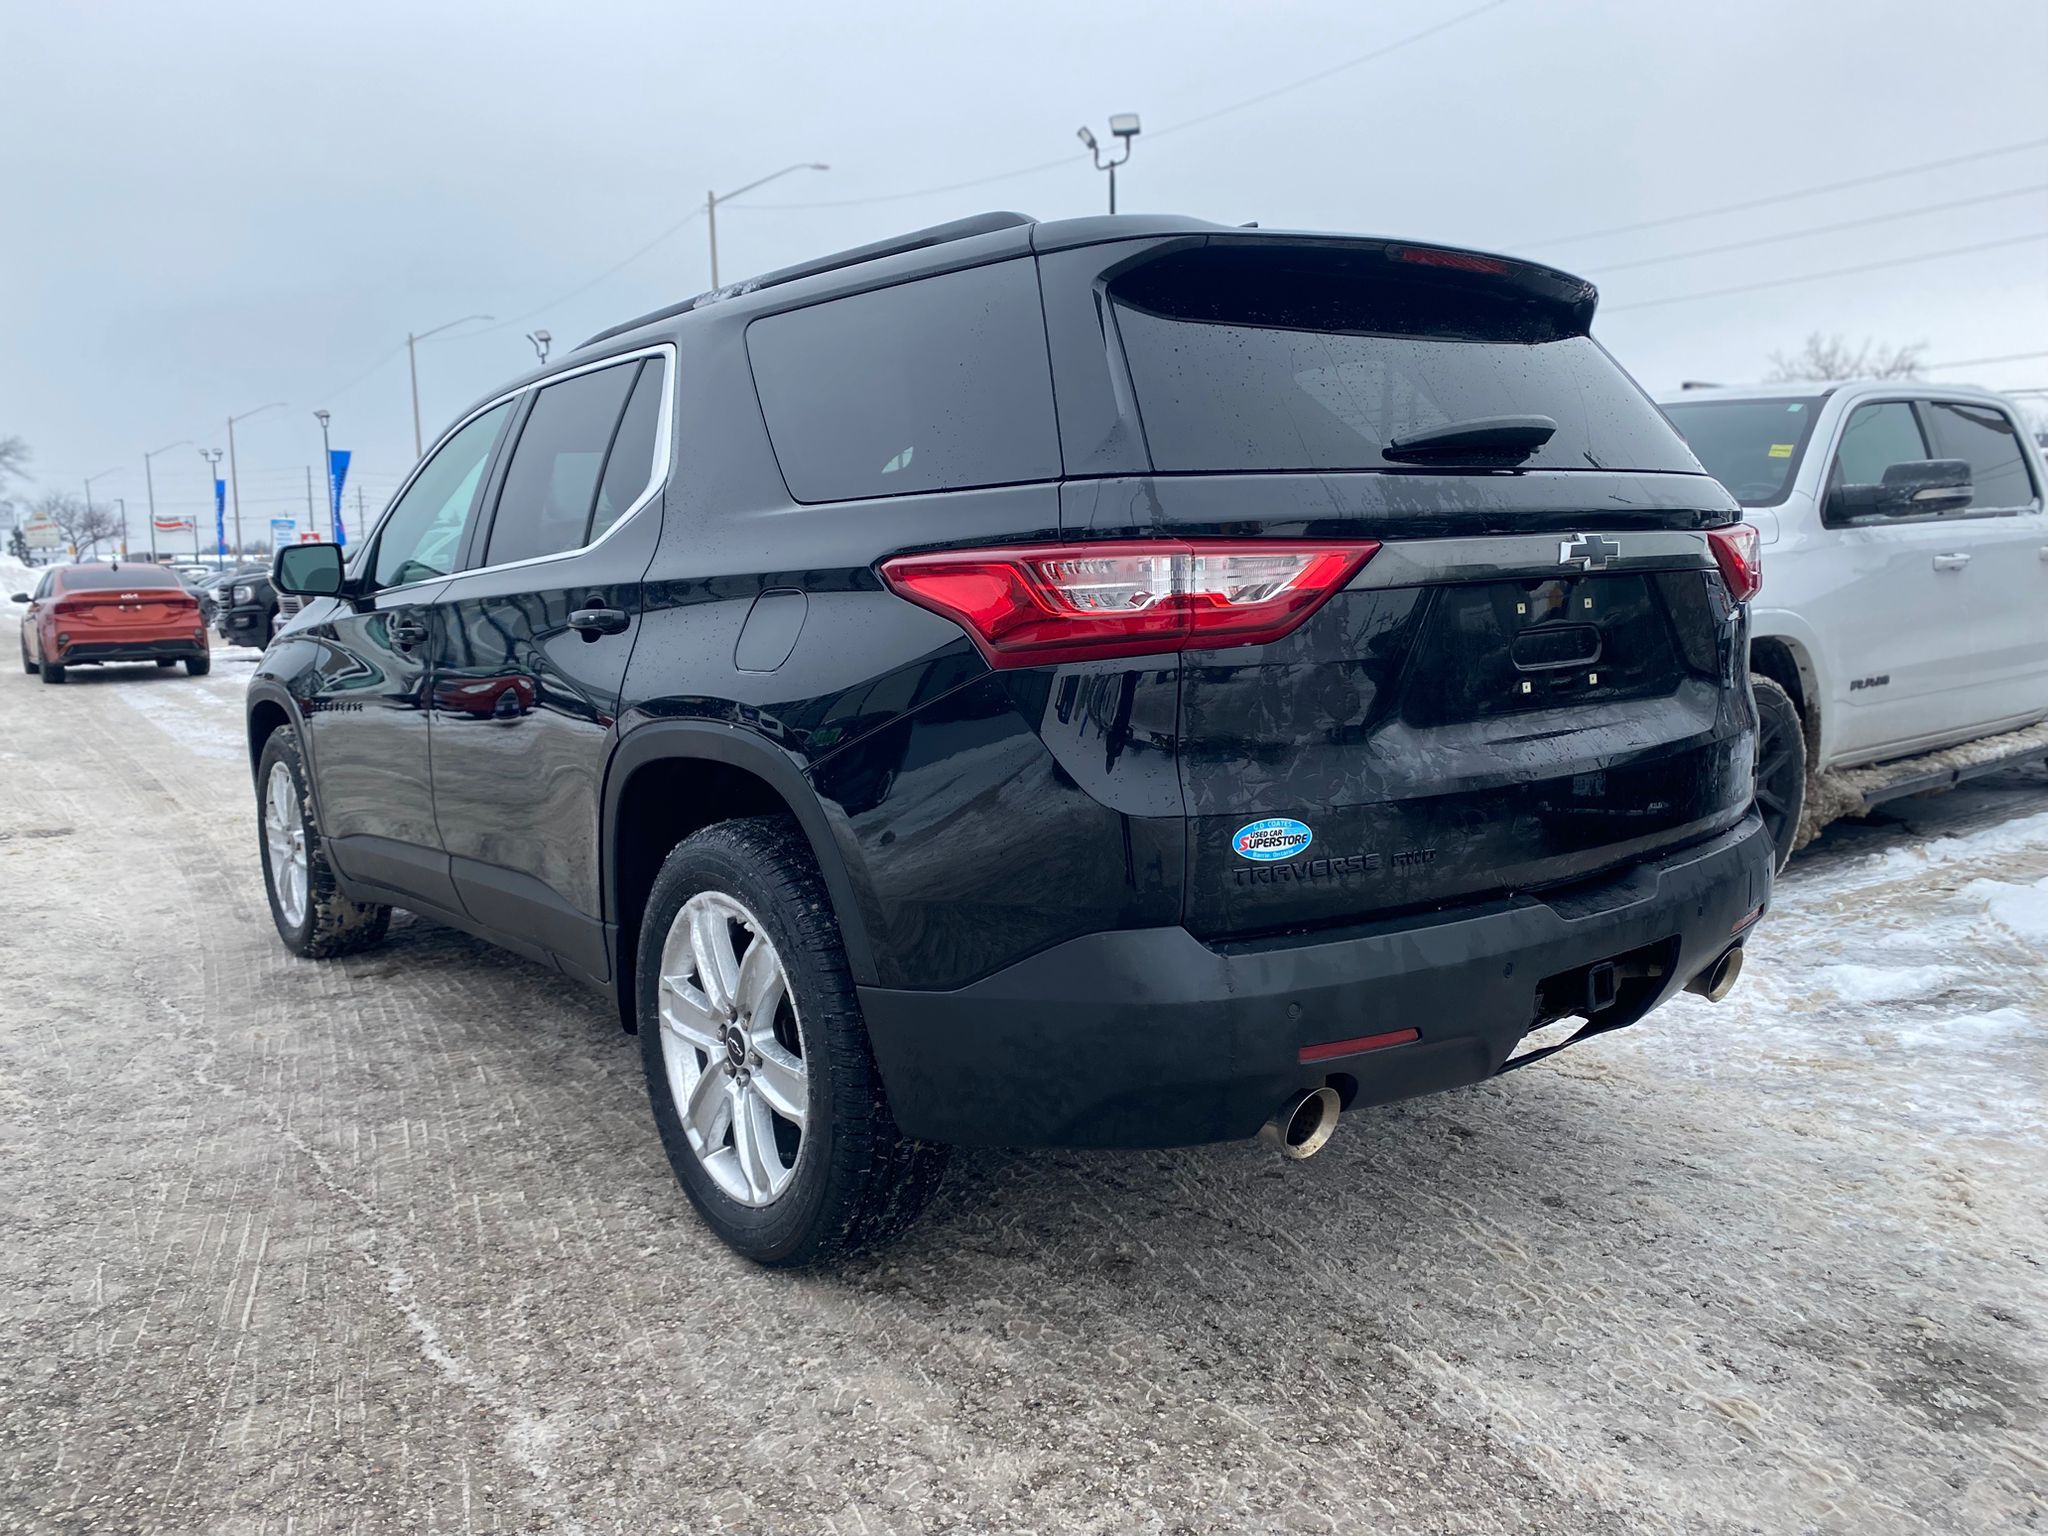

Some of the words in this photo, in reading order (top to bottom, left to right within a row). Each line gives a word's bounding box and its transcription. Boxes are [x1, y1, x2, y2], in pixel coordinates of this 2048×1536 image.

[1238, 833, 1308, 852] SUPERSTORE
[1250, 831, 1269, 839] USED
[1269, 829, 1283, 837] CAR
[1232, 853, 1380, 886] TRAVERSE
